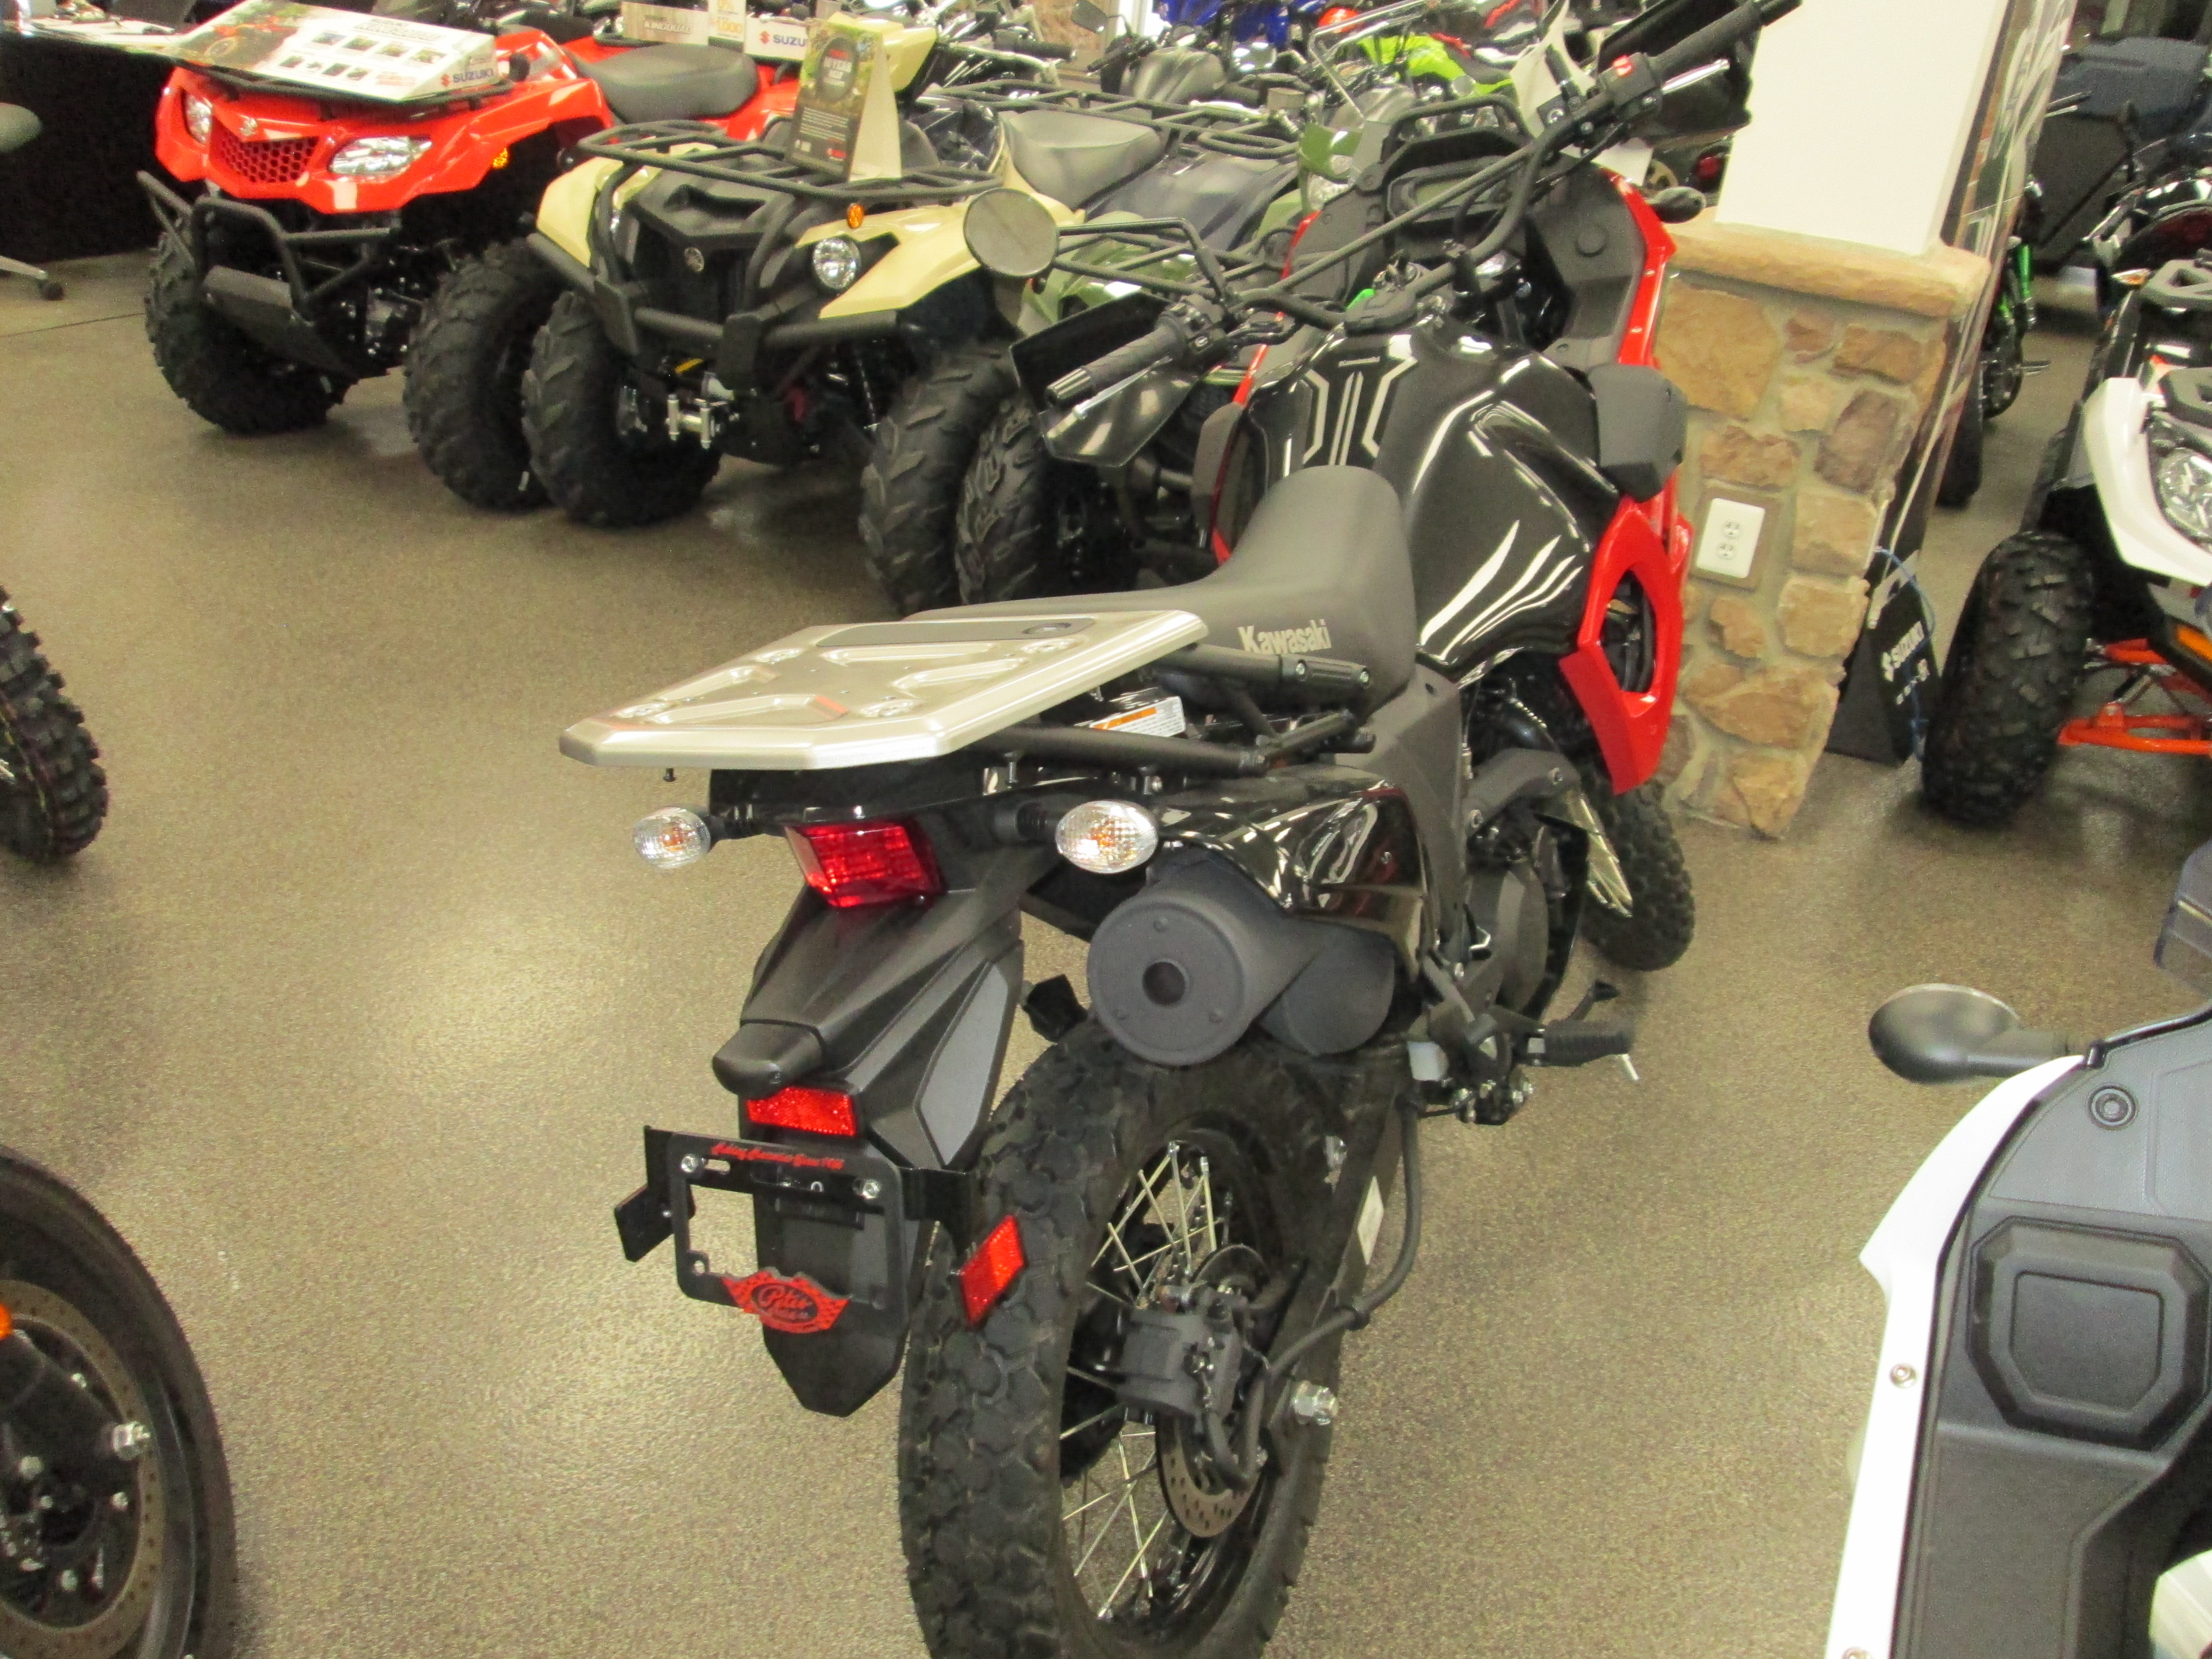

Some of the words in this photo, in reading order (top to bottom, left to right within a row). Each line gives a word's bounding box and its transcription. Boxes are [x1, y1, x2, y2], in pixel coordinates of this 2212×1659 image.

[773, 34, 807, 47] SUZU
[452, 68, 493, 83] SUZUKI
[1237, 618, 1332, 655] Kawasaki
